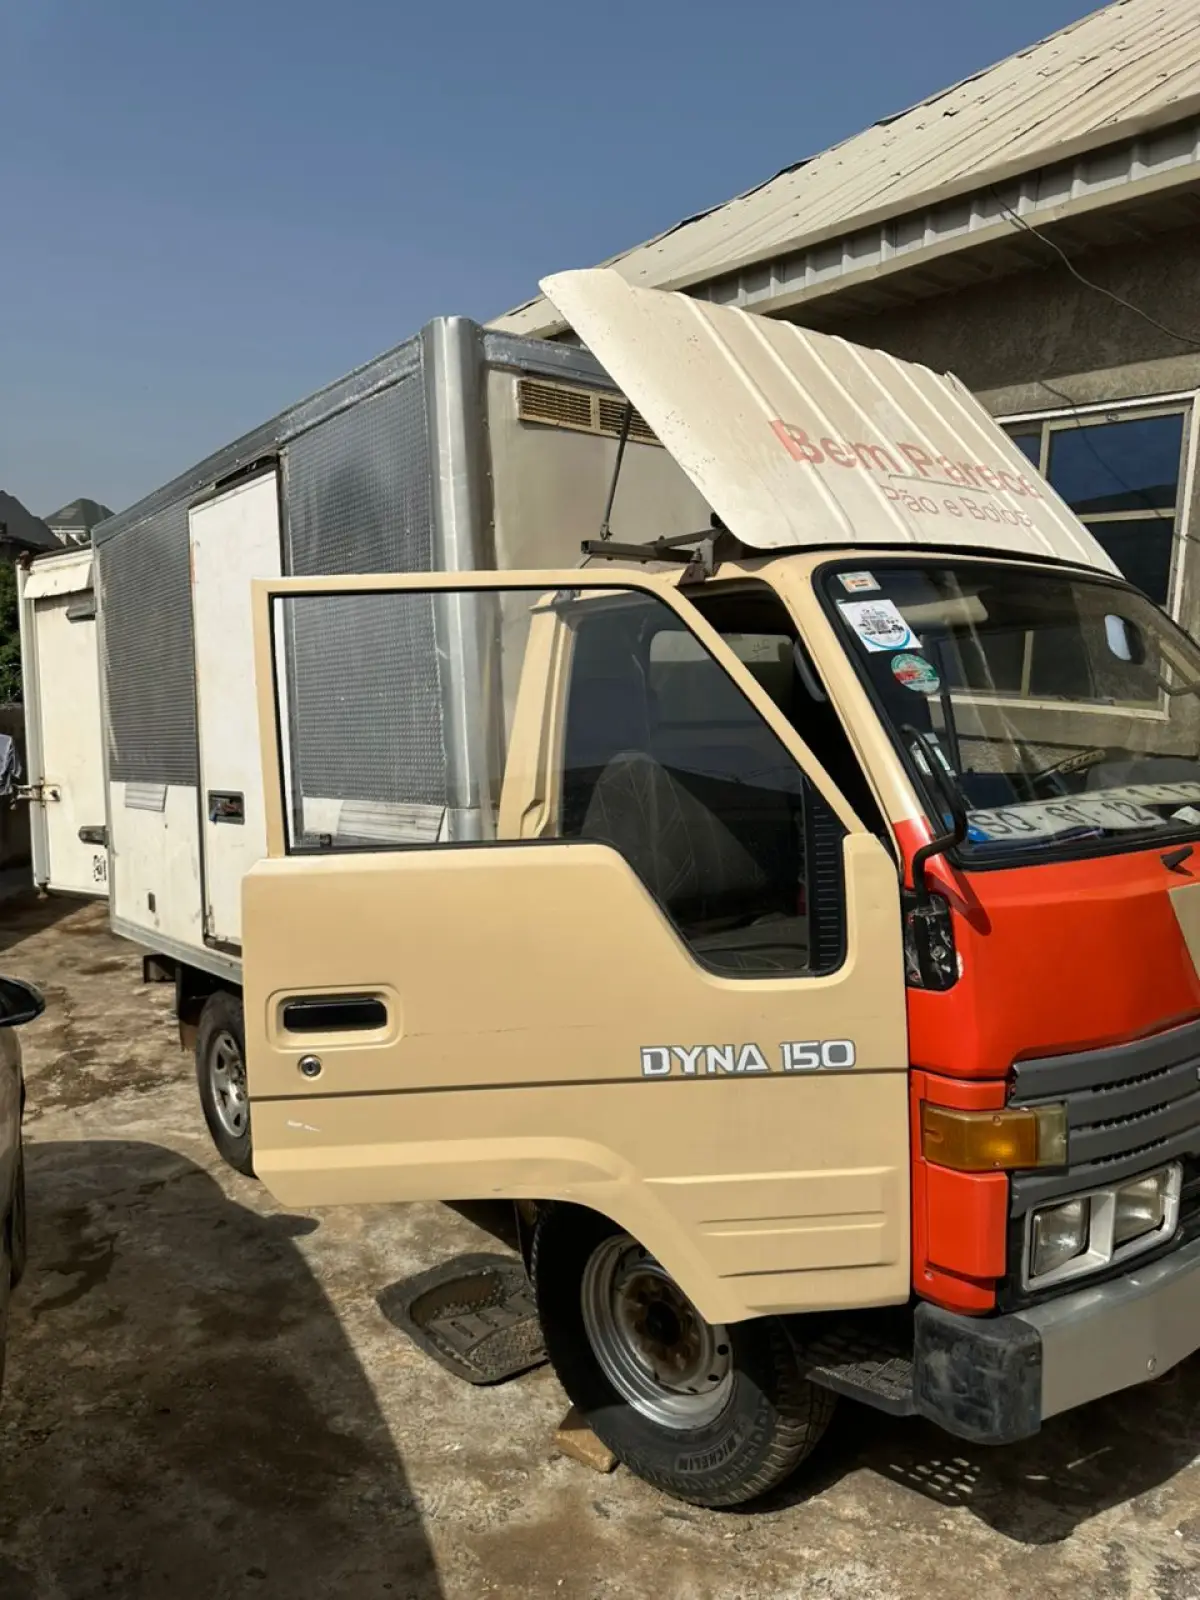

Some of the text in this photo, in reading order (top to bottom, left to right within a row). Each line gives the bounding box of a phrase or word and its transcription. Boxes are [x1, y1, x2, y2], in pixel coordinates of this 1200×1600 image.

[768, 418, 904, 474] Bem
[880, 484, 1033, 527] Pão e Bolos
[640, 1039, 856, 1076] DYNA 150
[678, 1432, 738, 1471] MICHELIN
